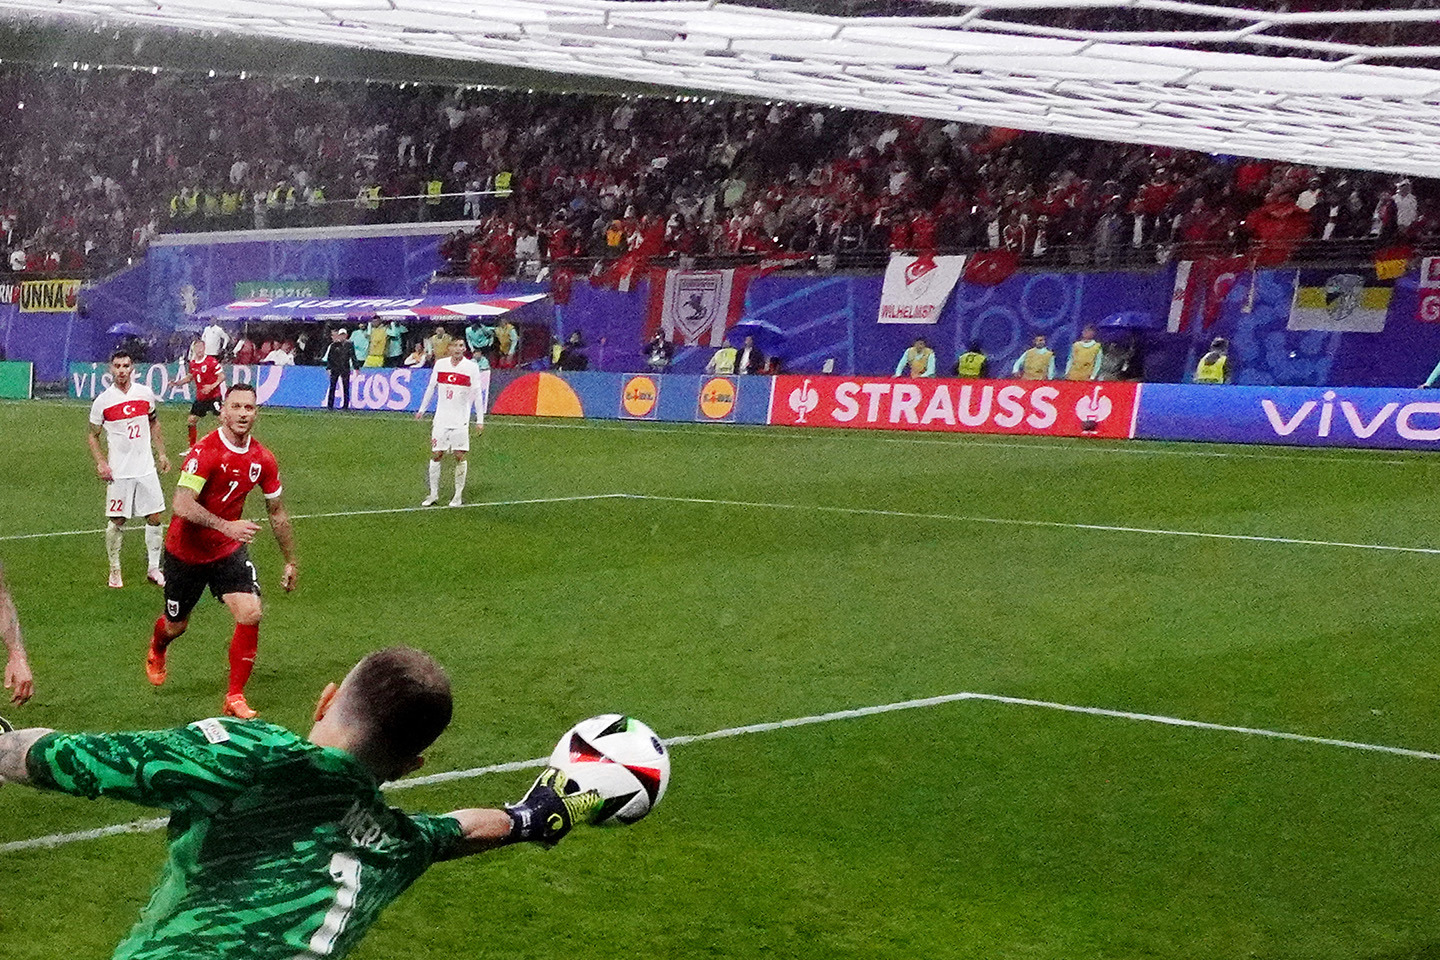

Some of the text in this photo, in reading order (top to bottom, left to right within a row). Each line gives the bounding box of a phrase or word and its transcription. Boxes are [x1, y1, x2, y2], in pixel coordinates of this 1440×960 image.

[21, 282, 65, 309] UNNA
[832, 382, 1058, 429] STRAUSS
[127, 425, 141, 439] 22
[222, 480, 239, 502] 7
[110, 499, 123, 512] 22
